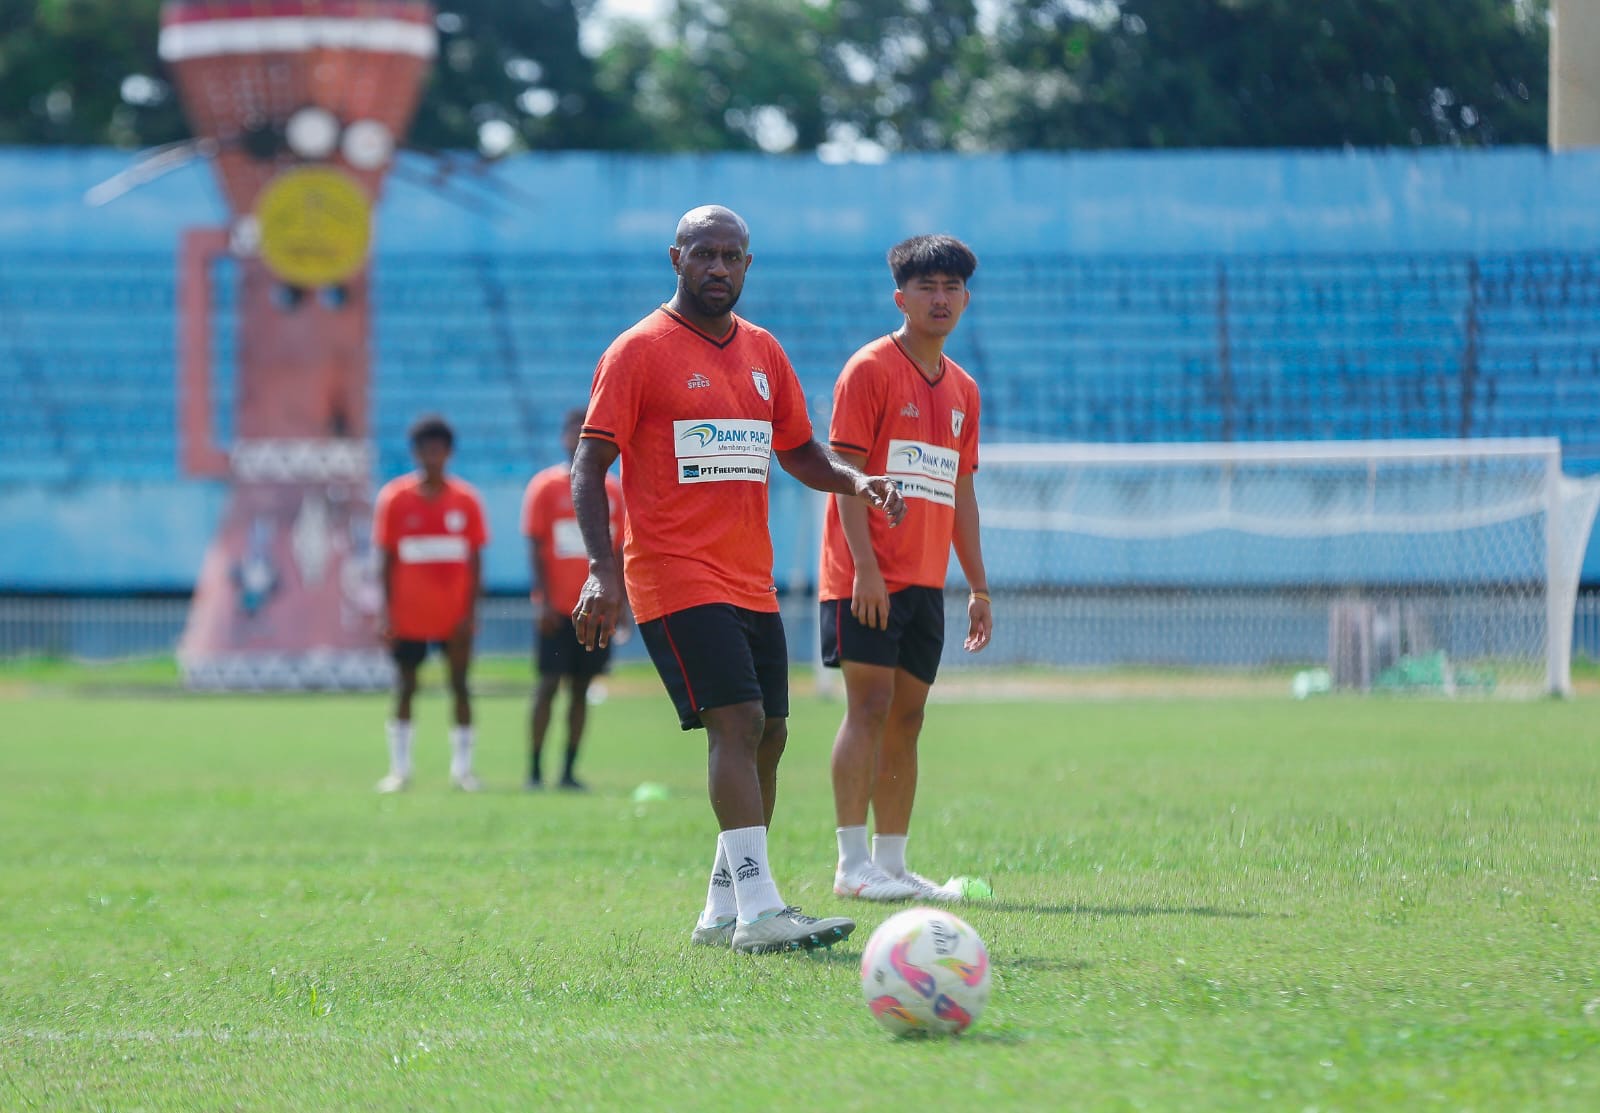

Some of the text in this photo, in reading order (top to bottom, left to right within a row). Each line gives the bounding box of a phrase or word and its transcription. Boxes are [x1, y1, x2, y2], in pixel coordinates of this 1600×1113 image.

[687, 379, 710, 389] SPECS
[717, 430, 747, 442] BANK
[701, 466, 712, 475] PT
[713, 466, 747, 474] FREEPORT
[738, 867, 760, 881] SPECS
[712, 877, 731, 888] SPECS
